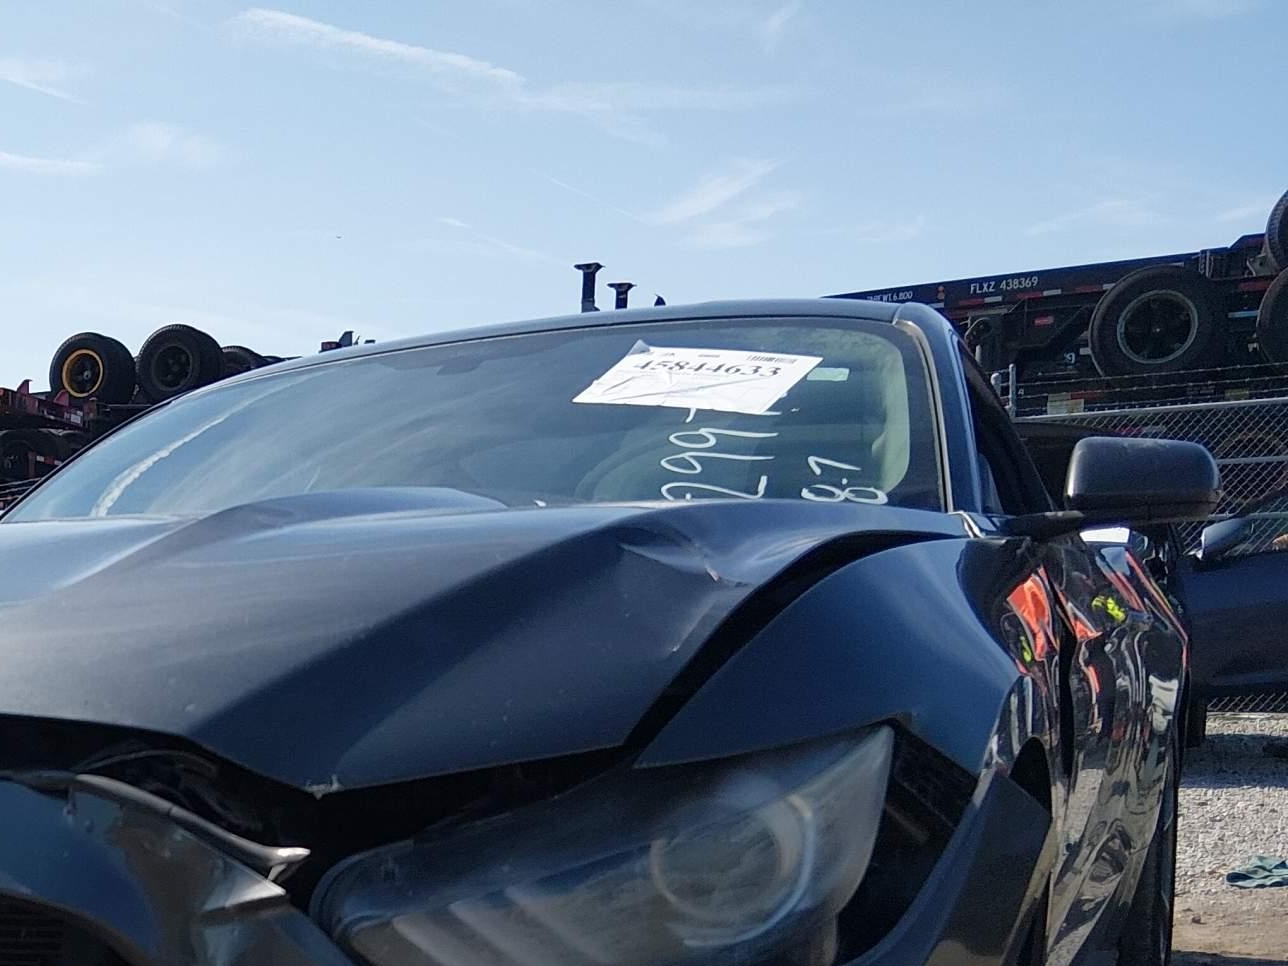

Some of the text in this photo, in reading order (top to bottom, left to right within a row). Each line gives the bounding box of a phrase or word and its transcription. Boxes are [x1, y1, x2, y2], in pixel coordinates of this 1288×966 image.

[970, 276, 1038, 294] FLXZ 438369
[633, 359, 782, 377] 45844633
